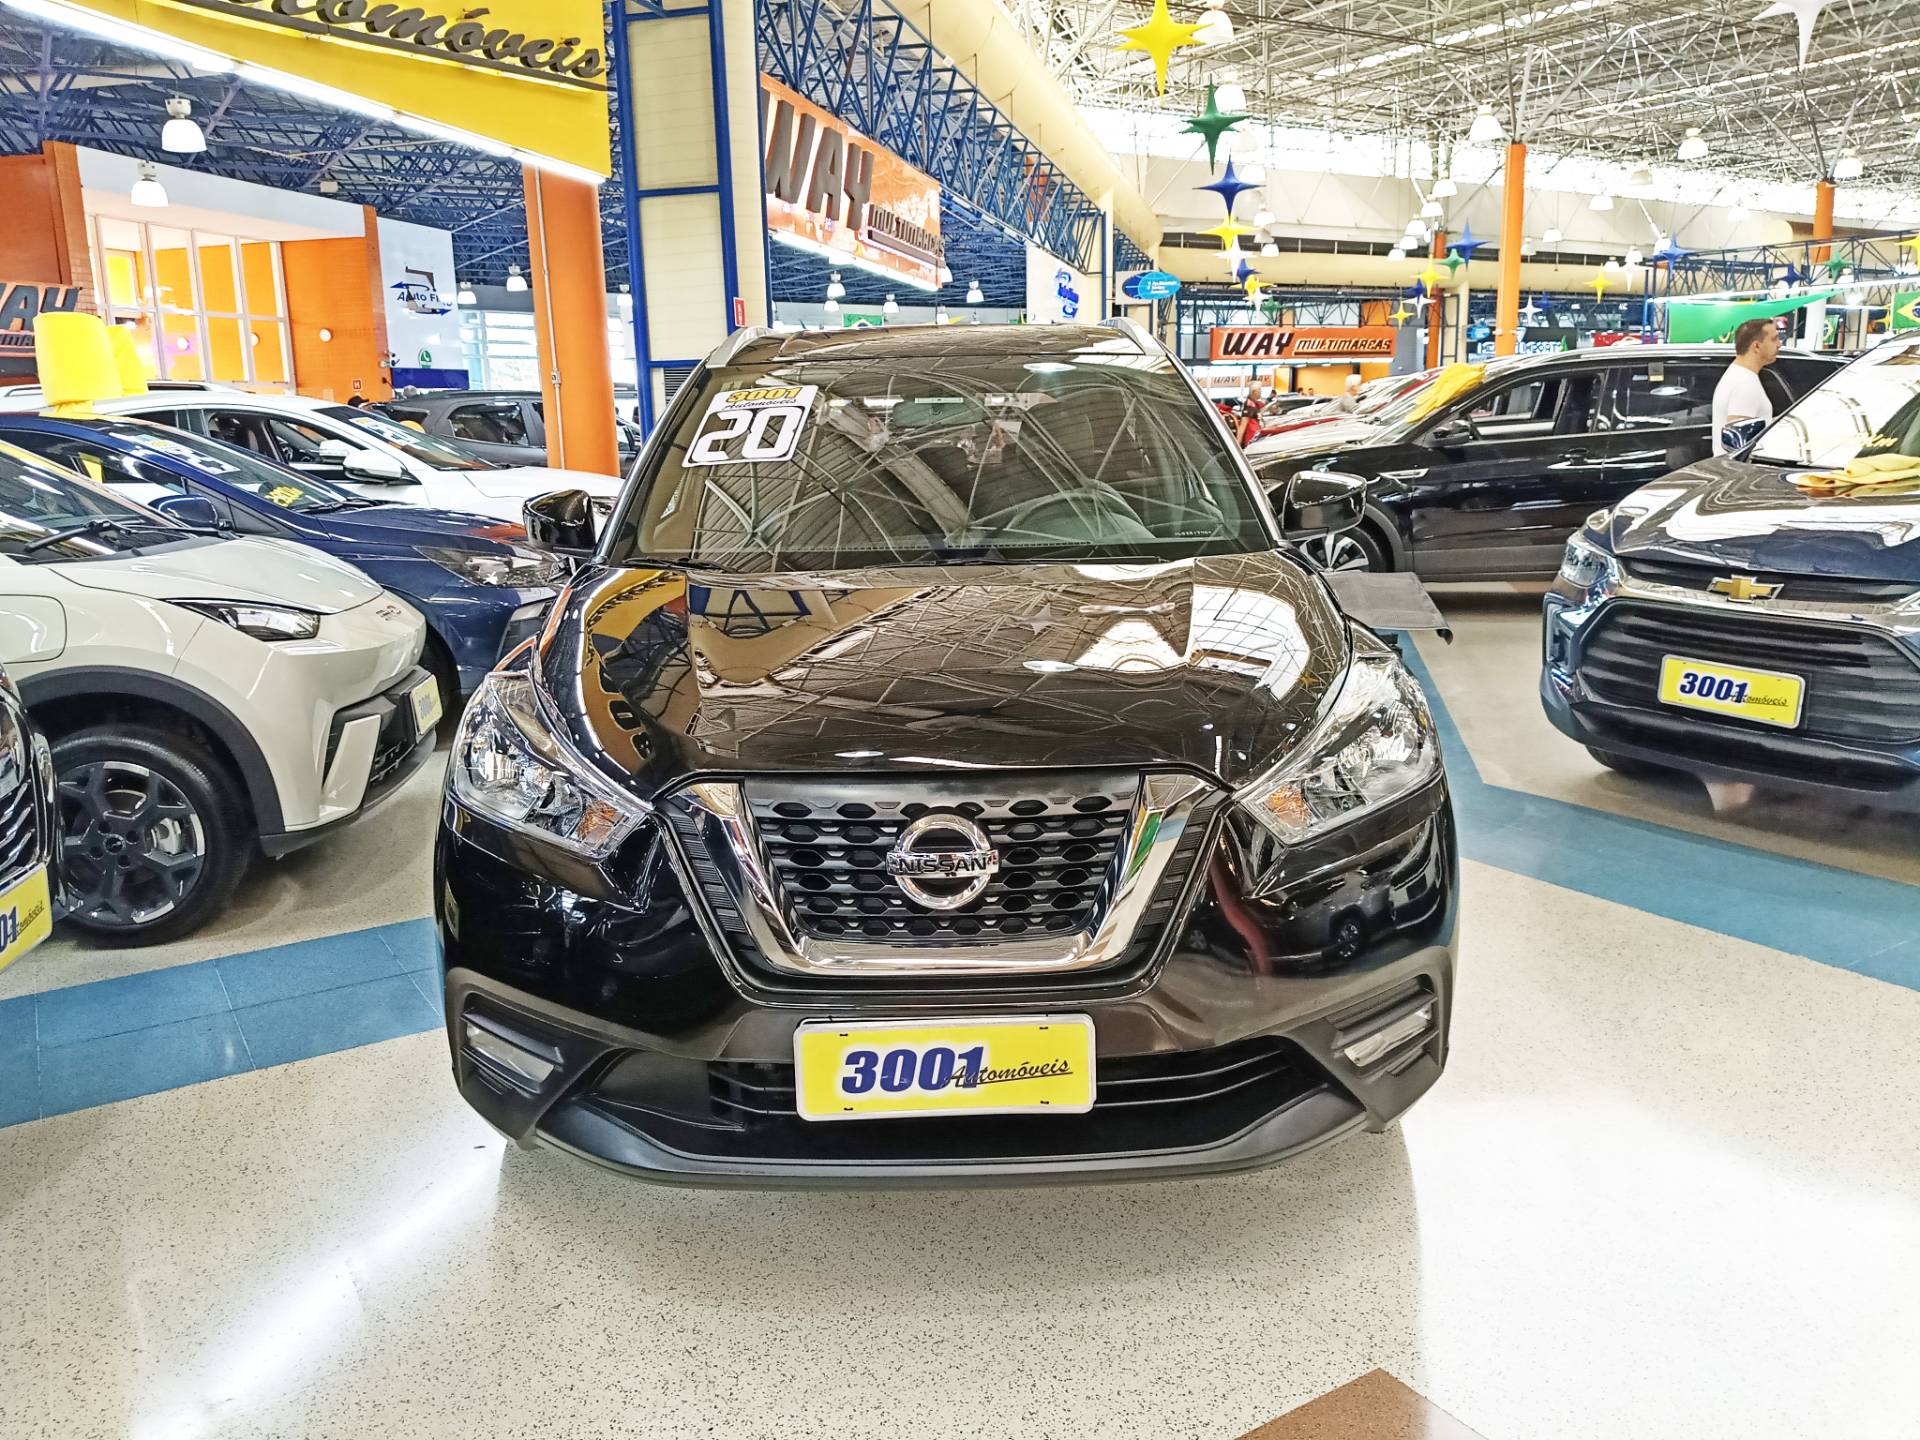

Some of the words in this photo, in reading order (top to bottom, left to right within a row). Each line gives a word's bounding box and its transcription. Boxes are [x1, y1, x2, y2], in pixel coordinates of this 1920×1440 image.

[1222, 332, 1295, 356] WAY
[1295, 337, 1393, 351] MULTIMARCAS
[726, 387, 803, 403] 3001
[691, 406, 803, 463] 20
[1679, 672, 1748, 704] 3001
[899, 856, 987, 873] NISSAN
[841, 1046, 985, 1094] 3001
[944, 1058, 1069, 1088] Automóveis
